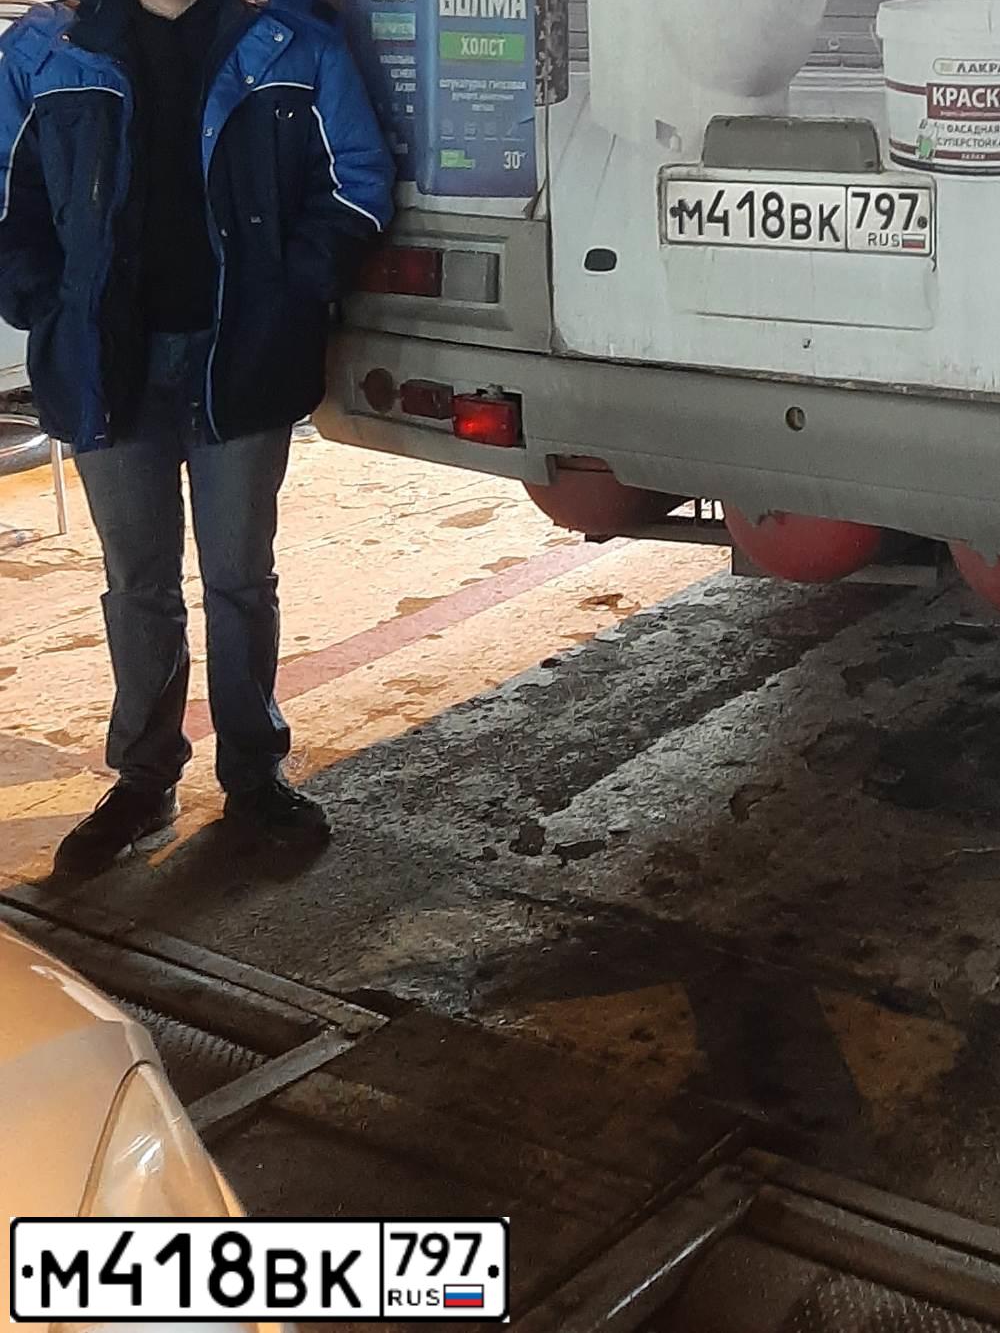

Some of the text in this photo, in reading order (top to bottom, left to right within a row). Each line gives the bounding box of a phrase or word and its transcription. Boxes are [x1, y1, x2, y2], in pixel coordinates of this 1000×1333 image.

[460, 35, 506, 56] ХОЛСТ
[851, 192, 919, 231] 797
[867, 232, 900, 247] RUS
